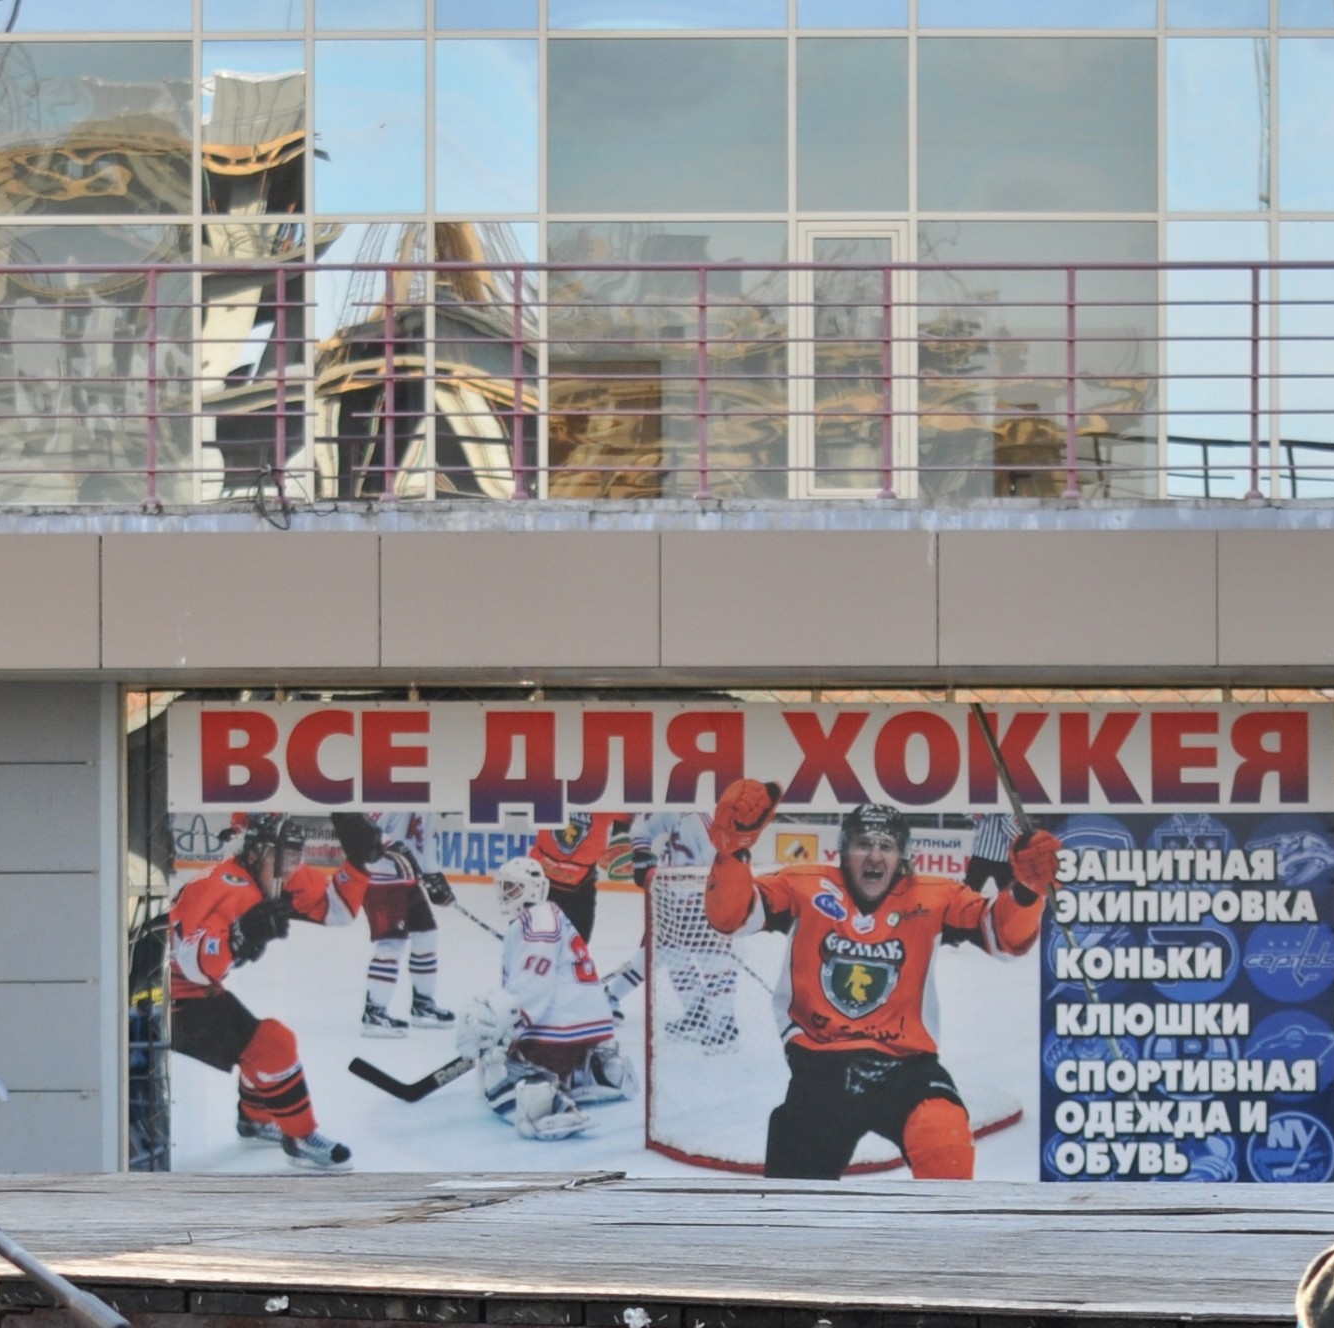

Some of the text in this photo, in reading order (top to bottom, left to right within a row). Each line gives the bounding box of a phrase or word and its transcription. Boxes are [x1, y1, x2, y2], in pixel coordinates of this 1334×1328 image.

[200, 710, 1310, 825] ВСЕ ДЛЯ ХОККЕЯ
[1055, 849, 1275, 887] ЗАЩИТНАЯ
[1055, 890, 1318, 923] ЭКИПИРОВКА
[1056, 947, 1223, 980] КОНЬКИ
[1056, 1003, 1250, 1036] КЛЮШКИ
[1055, 1059, 1317, 1093] СПОРТИВНАЯ
[1055, 1101, 1268, 1139] ОДЕЖДА И
[1055, 1142, 1189, 1175] ОБУВЬ
